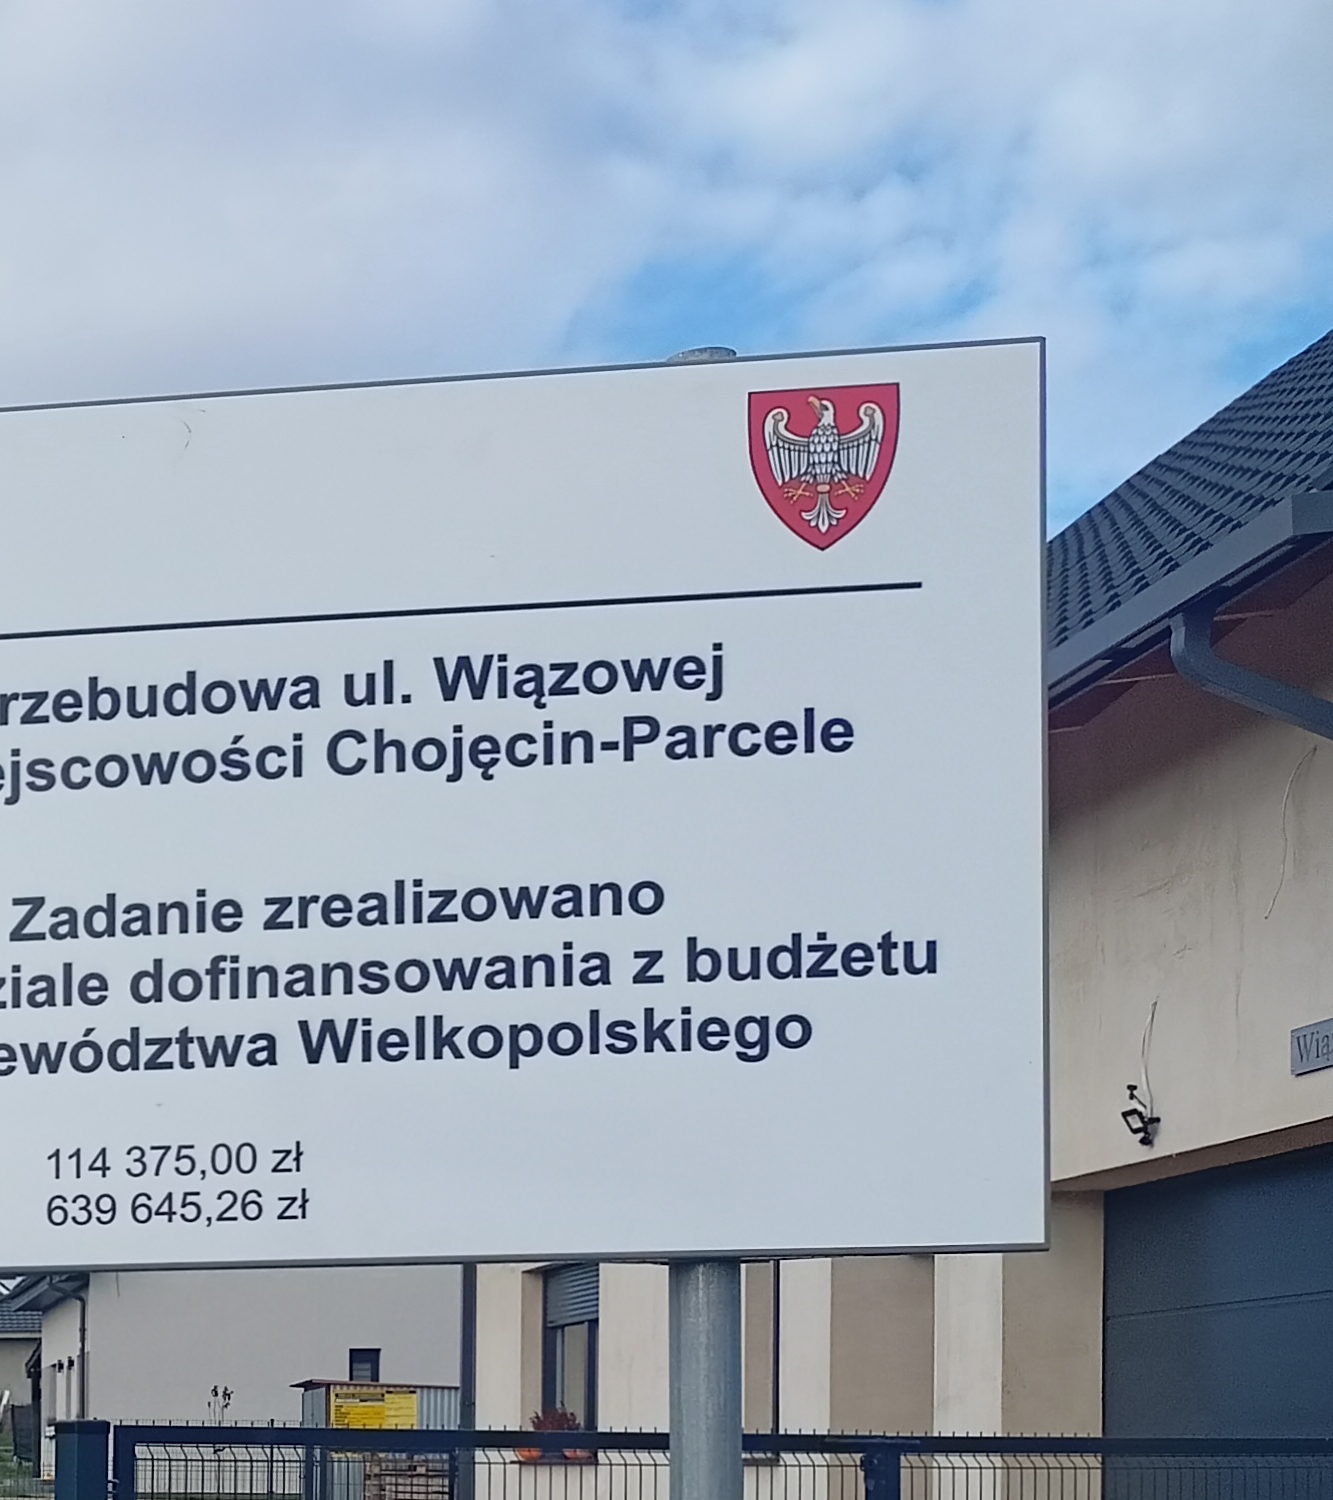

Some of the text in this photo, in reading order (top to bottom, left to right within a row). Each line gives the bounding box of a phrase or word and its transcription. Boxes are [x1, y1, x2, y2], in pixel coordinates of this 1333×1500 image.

[343, 658, 412, 708] ul.
[432, 641, 724, 710] Wiązowej
[326, 706, 855, 784] Chojęcin-Parcele
[8, 878, 665, 943] Zadanie zrealizowano
[129, 940, 612, 1005] dofinansowania
[631, 949, 665, 985] z
[686, 930, 938, 983] budżetu
[297, 1005, 813, 1070] Wielkopolskiego
[1296, 1030, 1333, 1063] Wią
[46, 1146, 112, 1180] 114
[125, 1141, 258, 1181] 375,00
[270, 1140, 304, 1174] zł
[46, 1192, 117, 1227] 639
[130, 1188, 264, 1228] 645,26
[276, 1187, 310, 1221] zł
